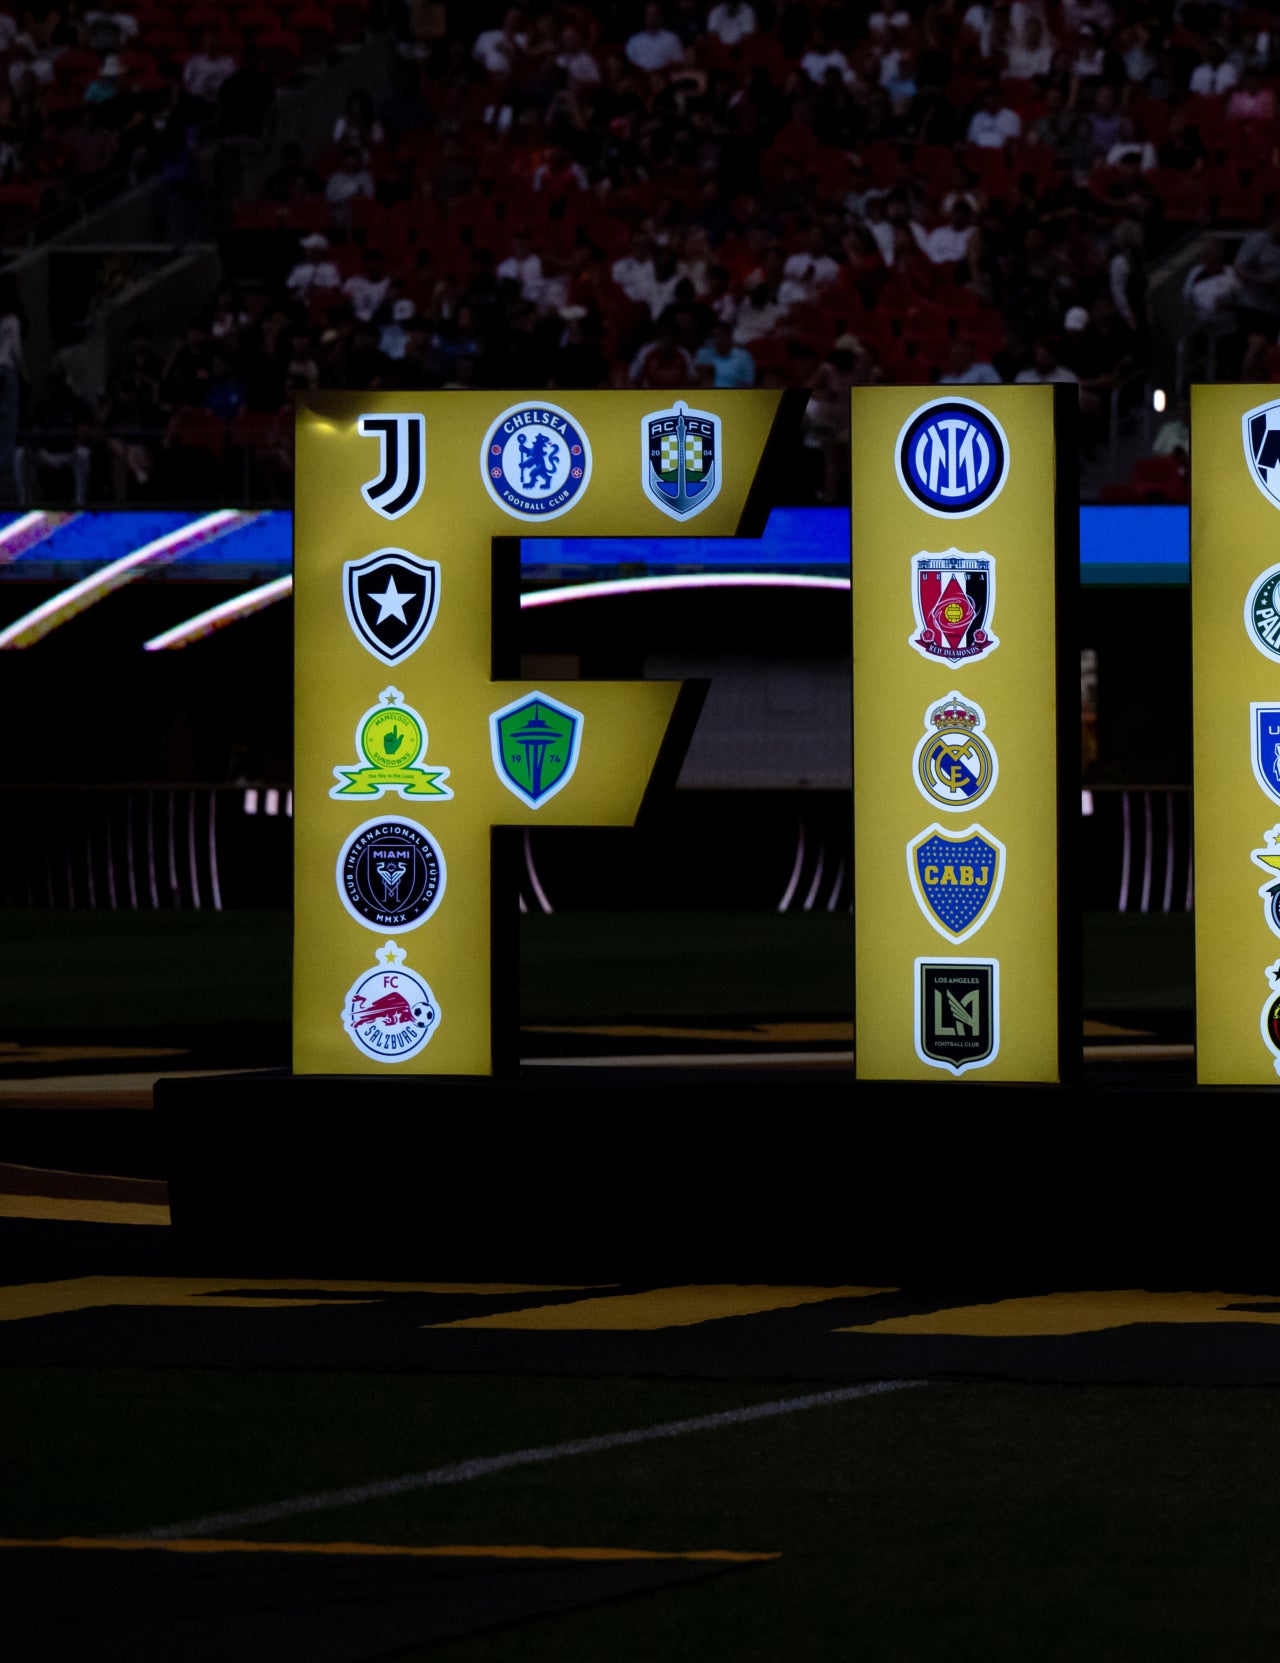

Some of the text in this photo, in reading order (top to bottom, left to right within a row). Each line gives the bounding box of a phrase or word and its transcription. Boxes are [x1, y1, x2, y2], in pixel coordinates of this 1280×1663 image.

[503, 411, 568, 435] CHELSEA
[651, 421, 711, 435] AC FC
[651, 449, 661, 457] 20
[503, 490, 570, 510] FOOTBALL CLUB
[943, 646, 980, 657] DIAMONDS
[375, 714, 410, 727] MAMELODI
[373, 752, 412, 766] SUNDOWNS
[511, 755, 521, 763] 19
[549, 755, 561, 763] 74
[373, 851, 410, 859] MIAMI
[346, 826, 438, 903] CLUB INTERNACIONAL DE FÚTBOL
[924, 866, 989, 886] CABJ
[376, 914, 407, 923] MMXX
[383, 976, 399, 988] FC
[364, 1025, 418, 1050] SALZBURG
